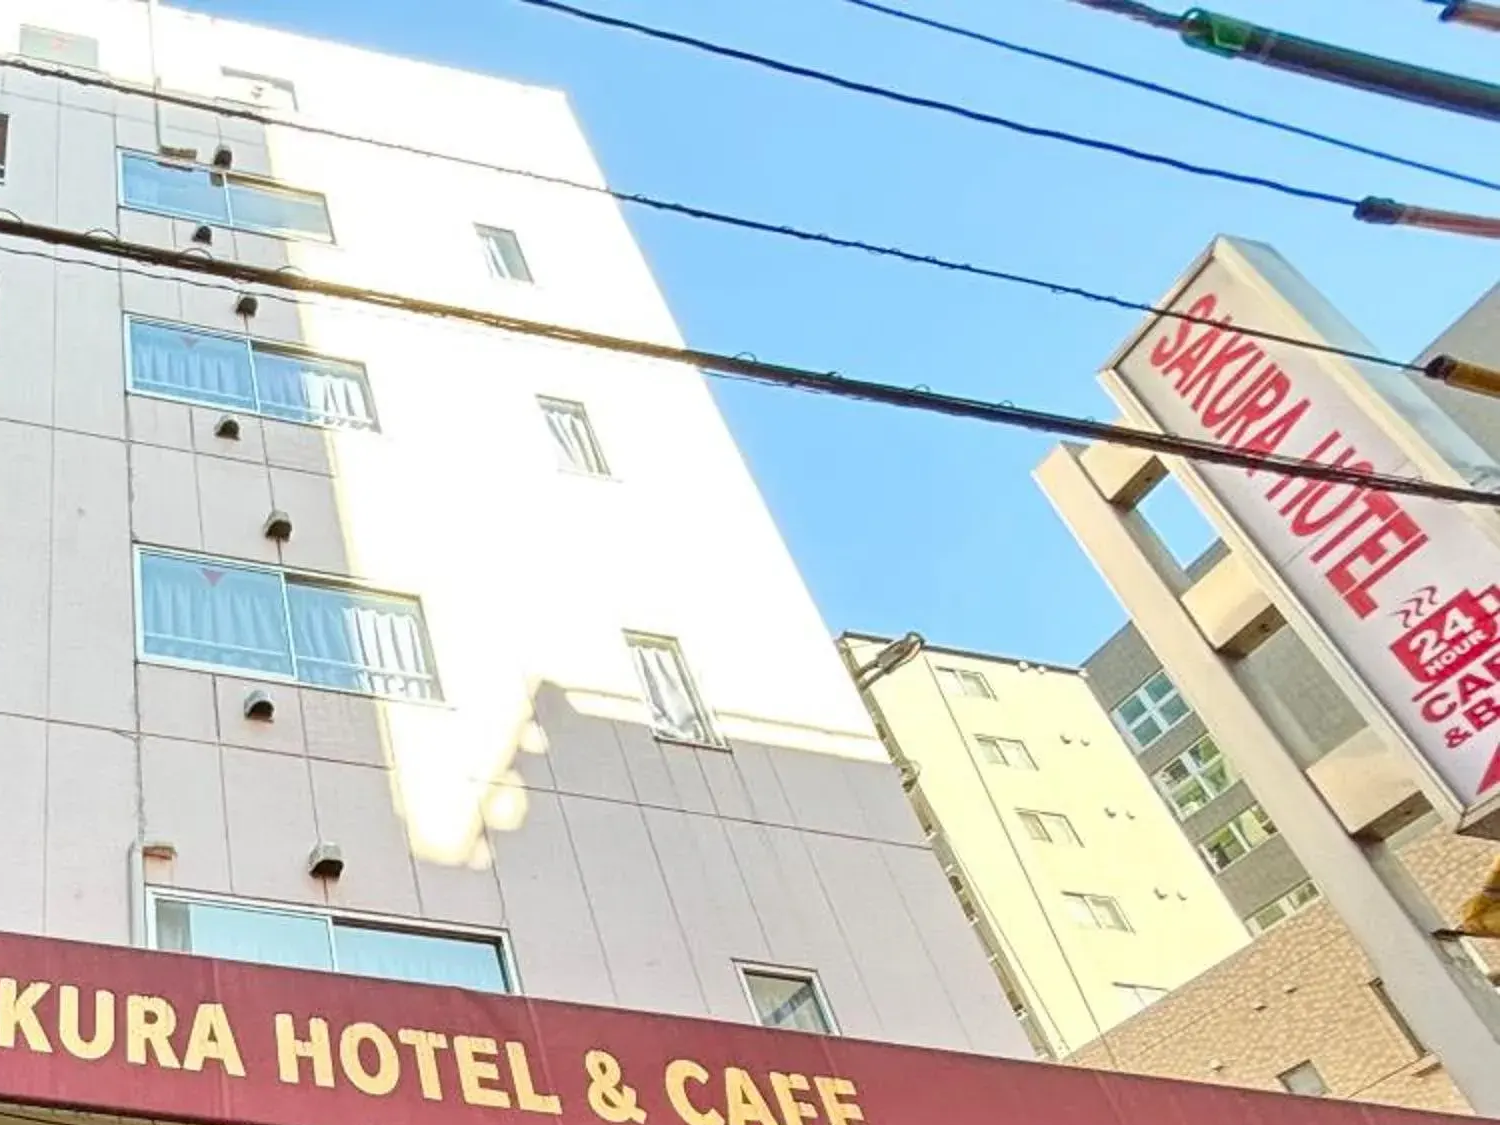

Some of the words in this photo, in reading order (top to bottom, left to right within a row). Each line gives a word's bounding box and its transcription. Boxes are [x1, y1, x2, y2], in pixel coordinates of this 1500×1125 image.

[1149, 293, 1311, 477] SAKURA
[1264, 429, 1429, 619] HOTEL
[1409, 607, 1476, 666] 24
[1424, 629, 1488, 676] HOUR
[275, 1013, 563, 1116] HOTEL
[585, 1049, 647, 1125] &
